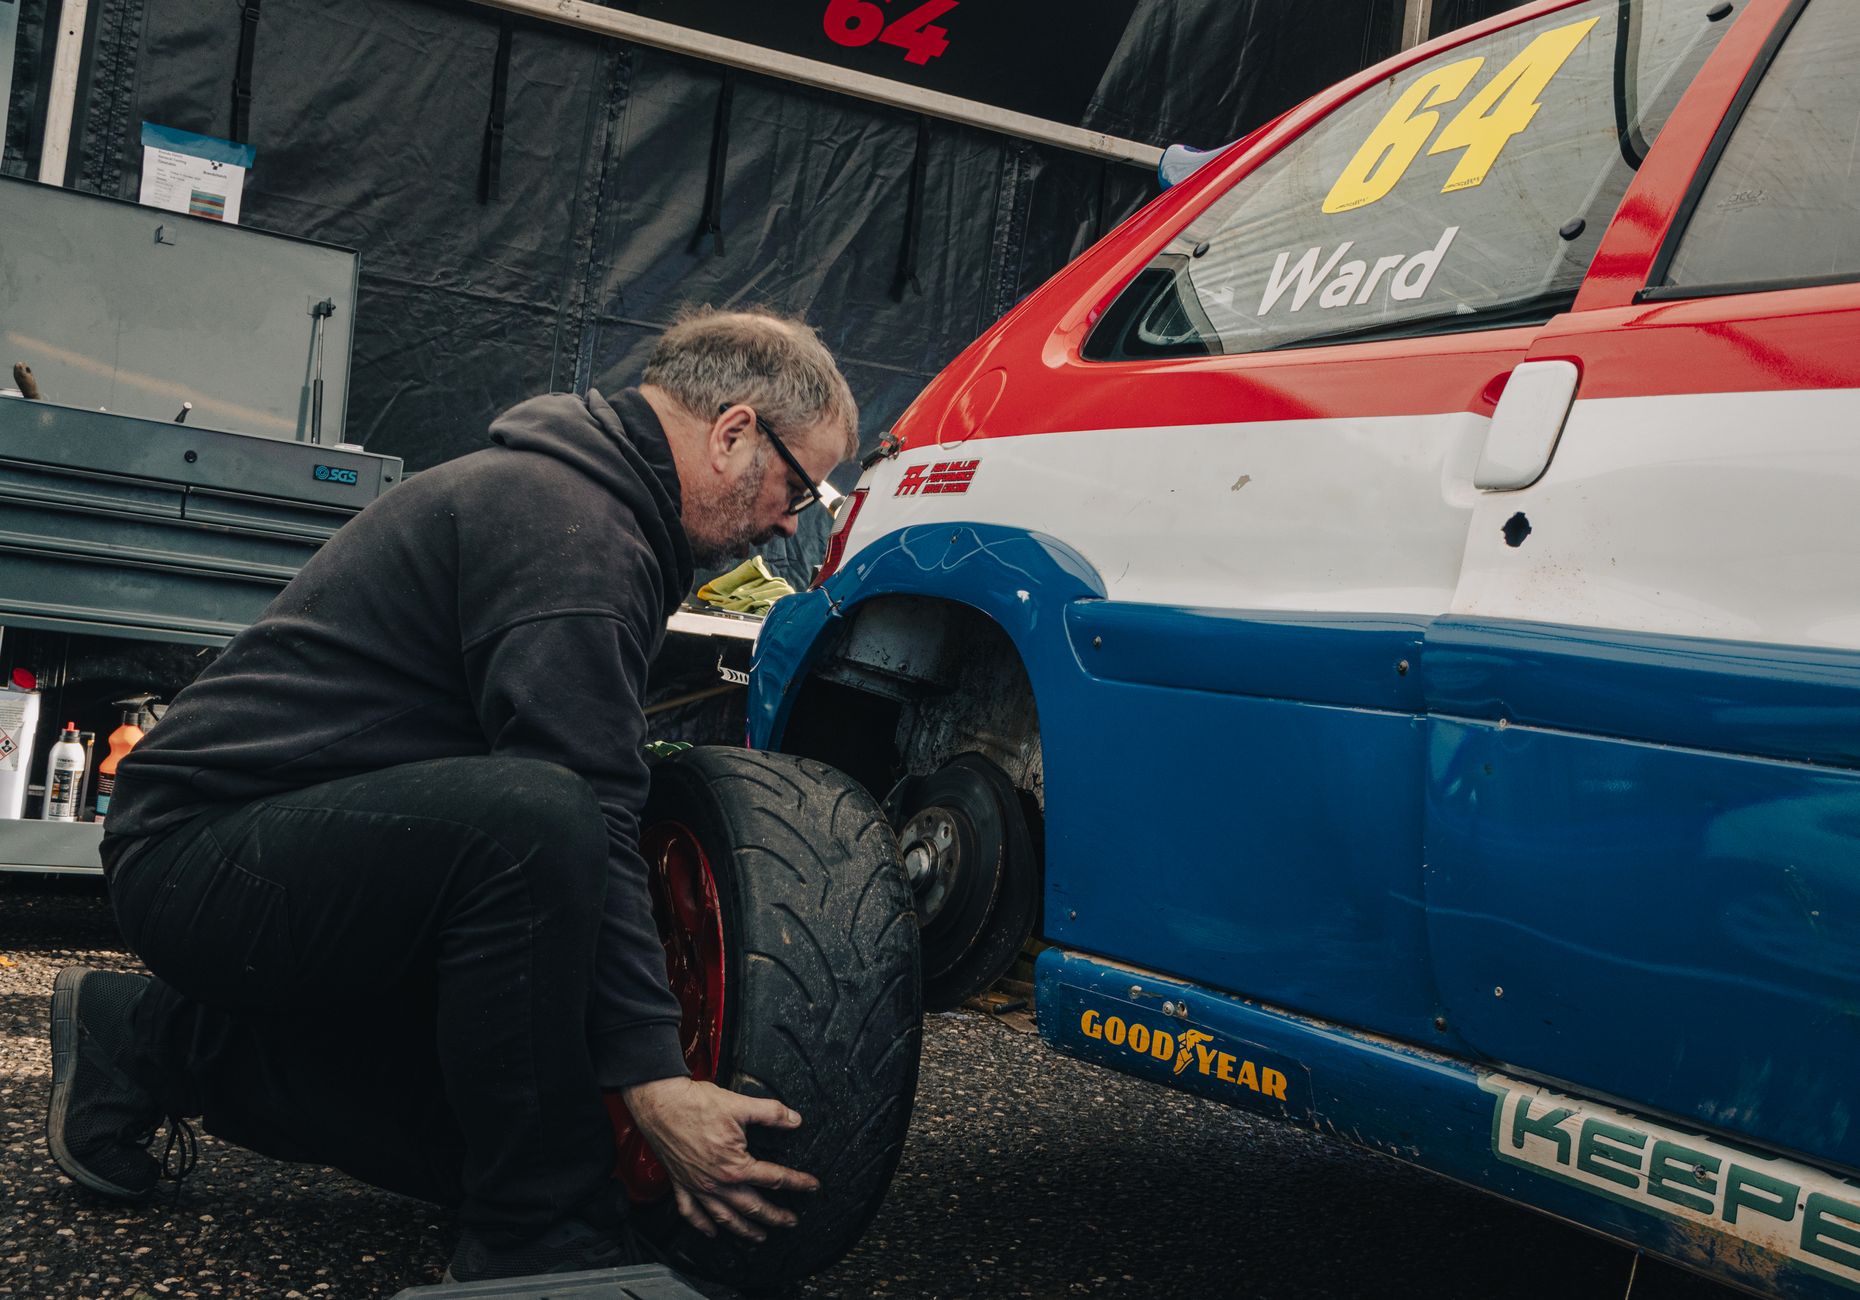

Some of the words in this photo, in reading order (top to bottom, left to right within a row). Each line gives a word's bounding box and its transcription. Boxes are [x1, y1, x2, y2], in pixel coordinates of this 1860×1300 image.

[823, 0, 960, 65] 64
[1321, 16, 1601, 215] 64
[1257, 226, 1460, 316] Ward
[328, 468, 357, 483] SGS
[1080, 1009, 1287, 1102] GOODYEAR
[1511, 1093, 1860, 1270] KEEPE
